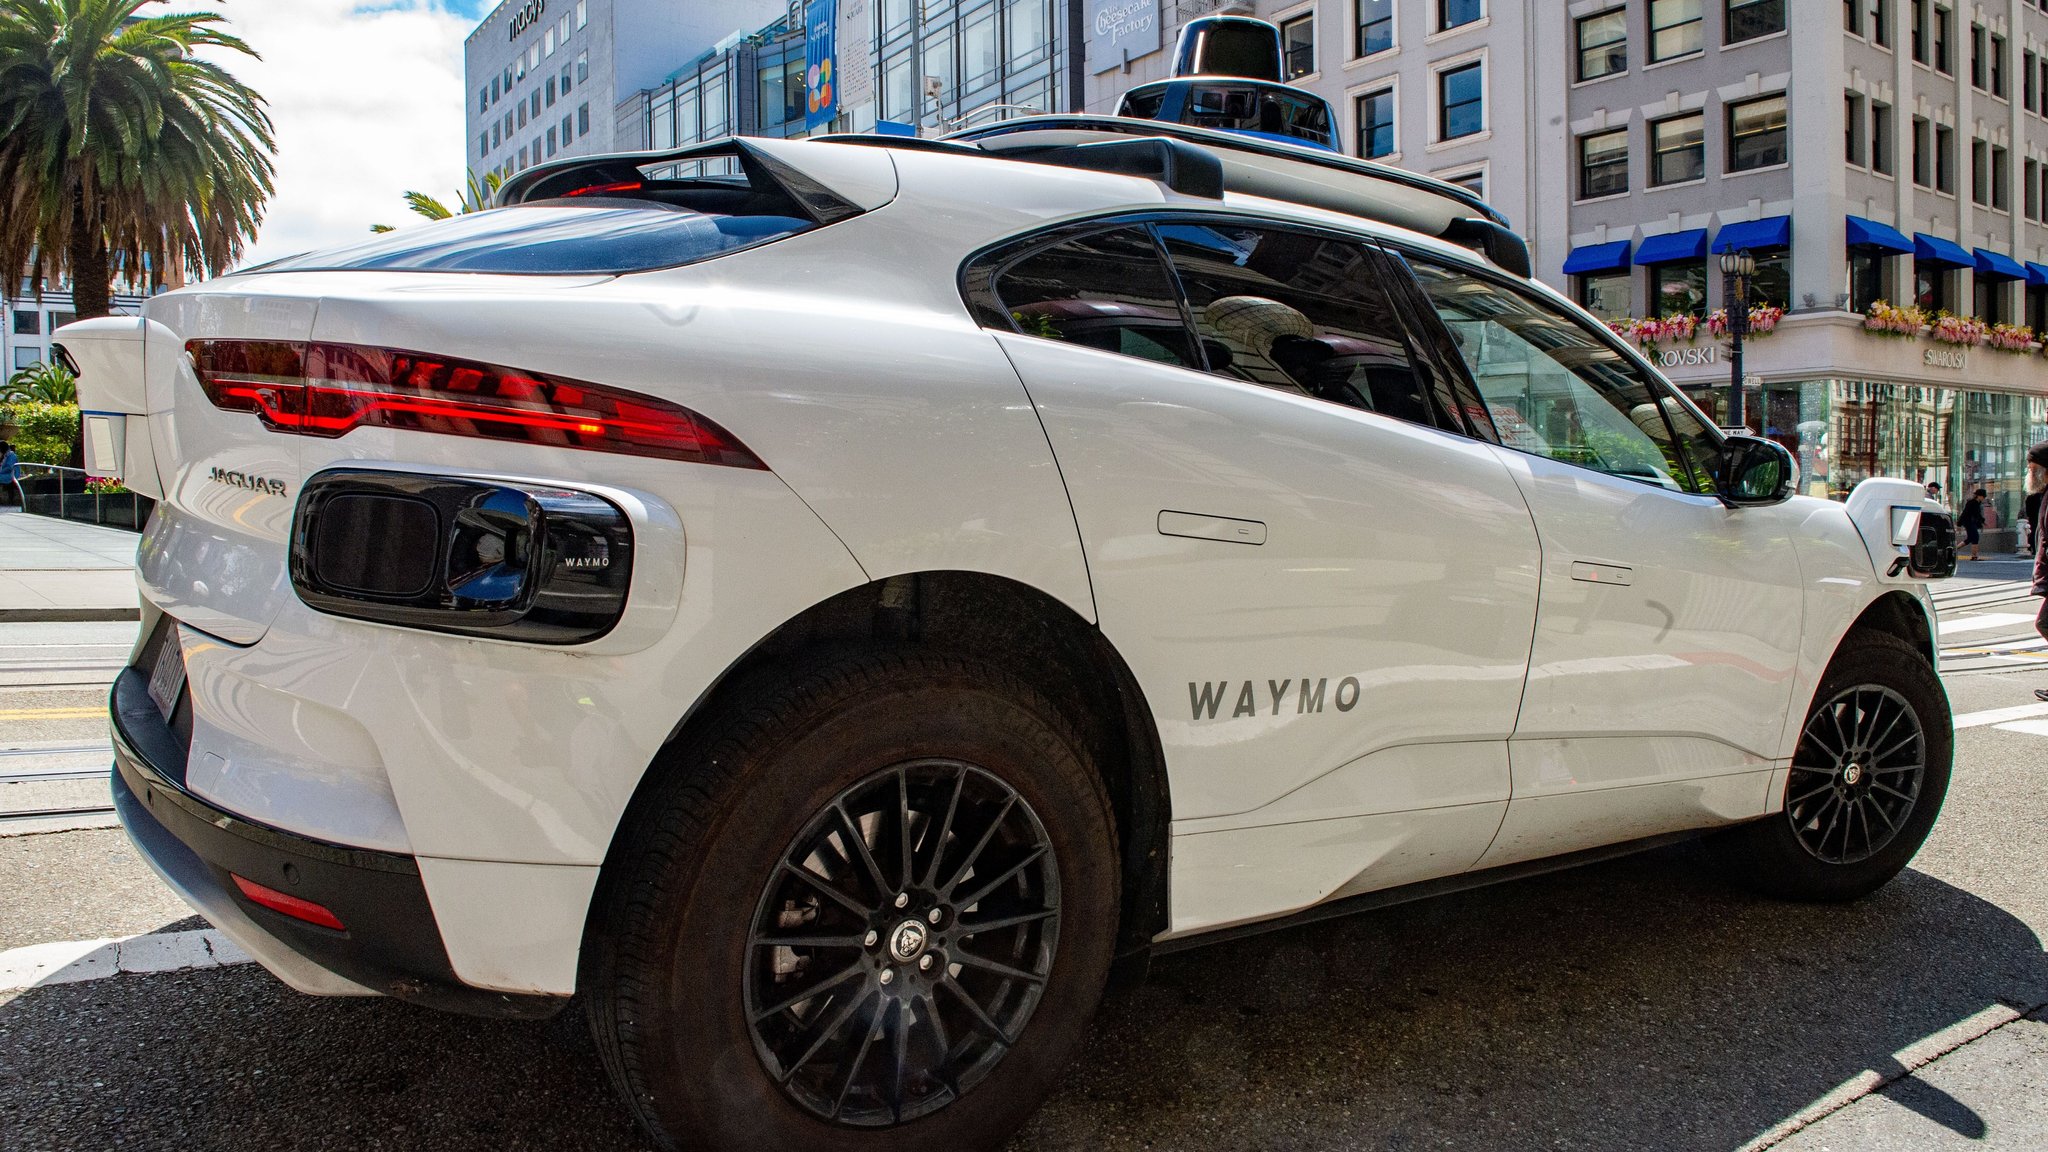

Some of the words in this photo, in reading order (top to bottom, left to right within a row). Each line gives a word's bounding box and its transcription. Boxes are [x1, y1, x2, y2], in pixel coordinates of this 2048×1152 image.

[1107, 14, 1153, 47] Factory
[1925, 349, 1968, 369] SWAROVSKI
[208, 466, 287, 498] JAGUAR
[565, 557, 609, 567] WAYMO
[1188, 676, 1361, 721] WAYMO
